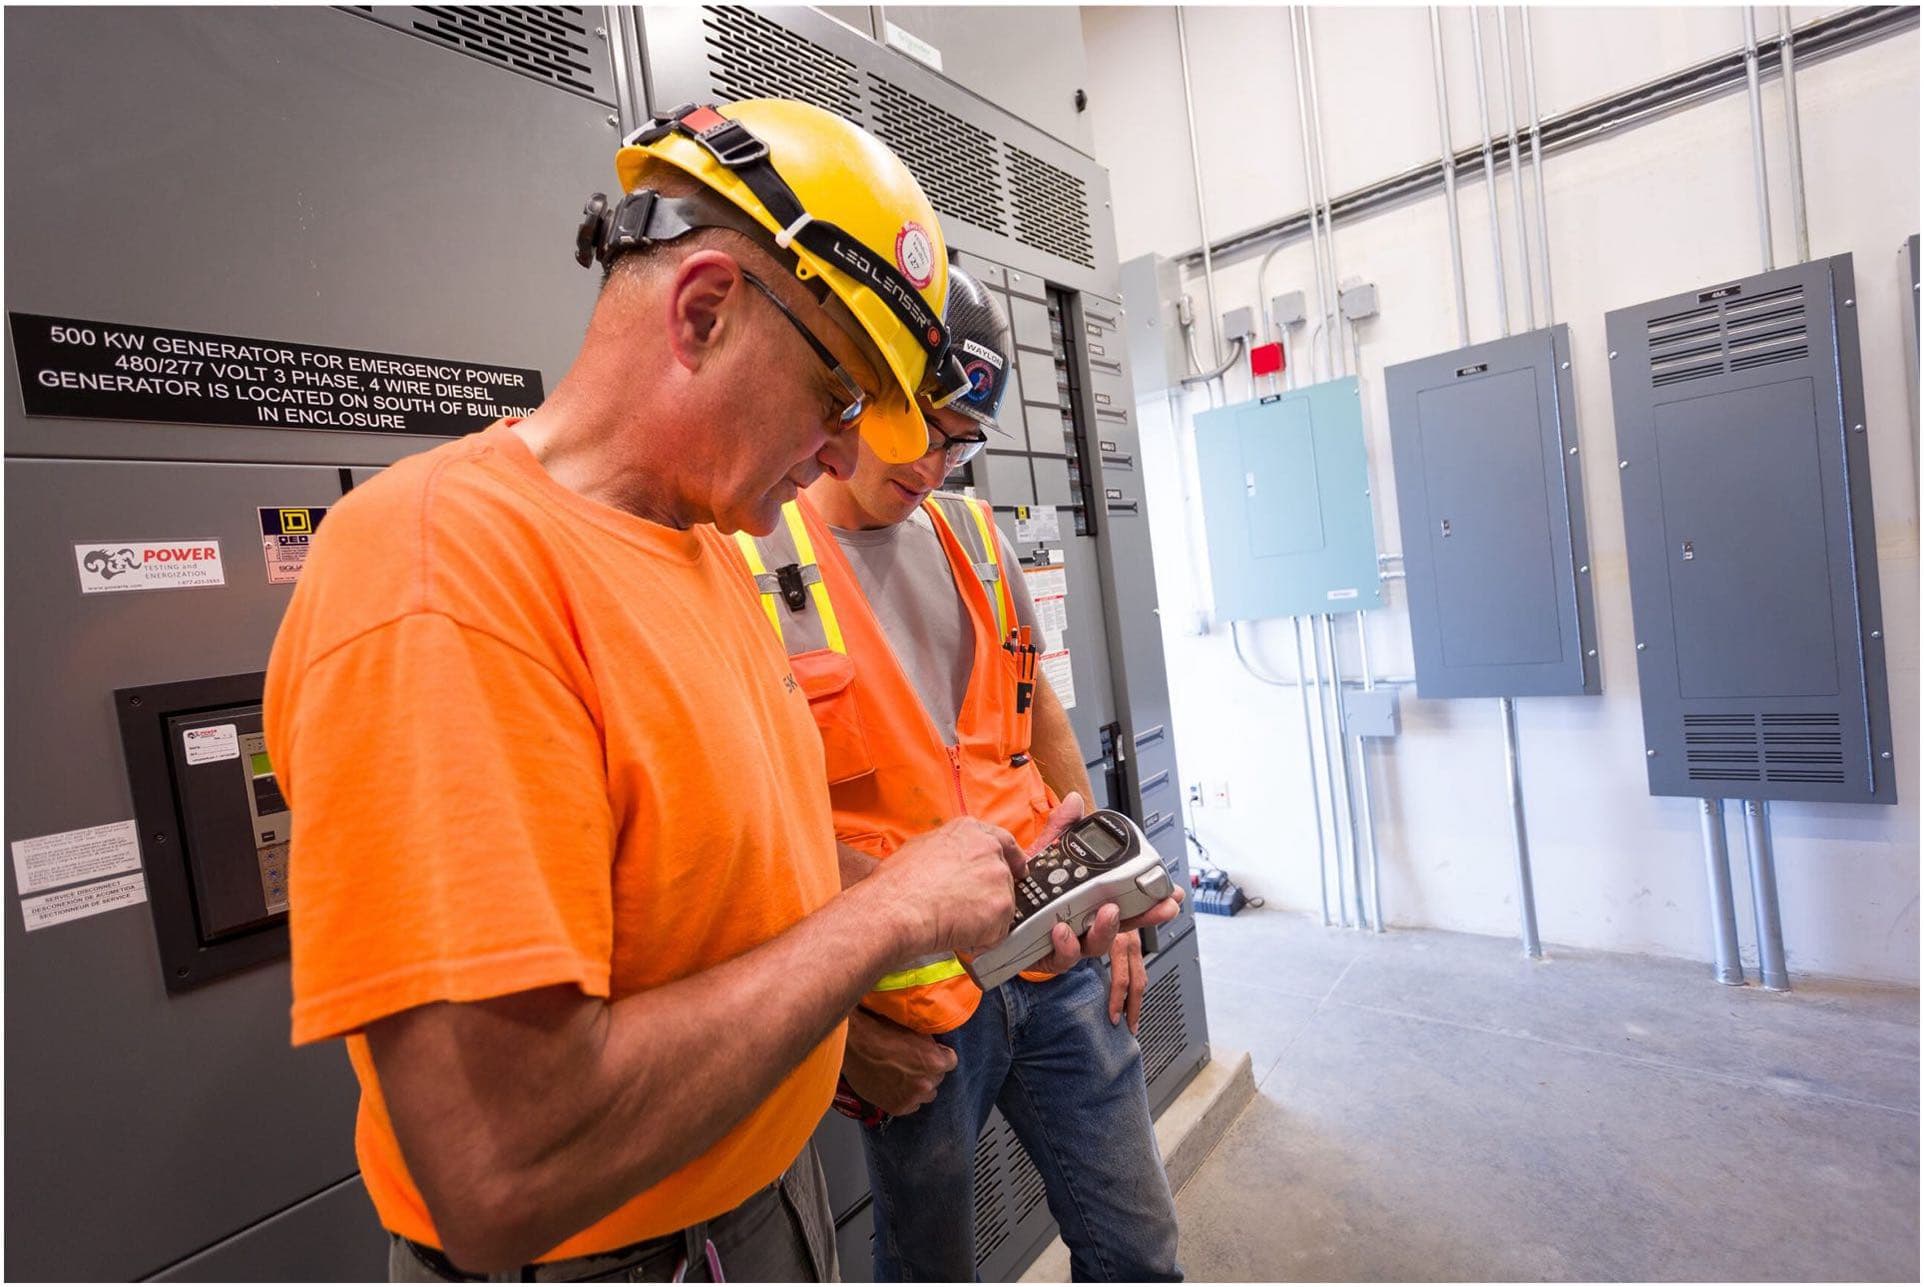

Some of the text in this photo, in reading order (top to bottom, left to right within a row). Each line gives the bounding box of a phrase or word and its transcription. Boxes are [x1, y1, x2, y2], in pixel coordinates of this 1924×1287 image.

[872, 267, 928, 328] LENSER
[51, 326, 525, 388] 500 KW GENERATOR FOR EMERGENCY POWER
[967, 343, 1002, 366] WAYLON
[38, 369, 202, 397] GENERATOR
[207, 382, 231, 399] IS
[235, 384, 334, 407] LOCATED
[338, 393, 369, 409] ON
[372, 395, 436, 414] SOUTH
[439, 401, 464, 416] OF
[114, 354, 494, 401] 480/277 VOLT 3 PHASE, 4 WIRE DIESEL
[257, 406, 406, 429] IN ENCLOSURE
[143, 547, 217, 563] POWER
[144, 570, 207, 580] ENERGIZATION
